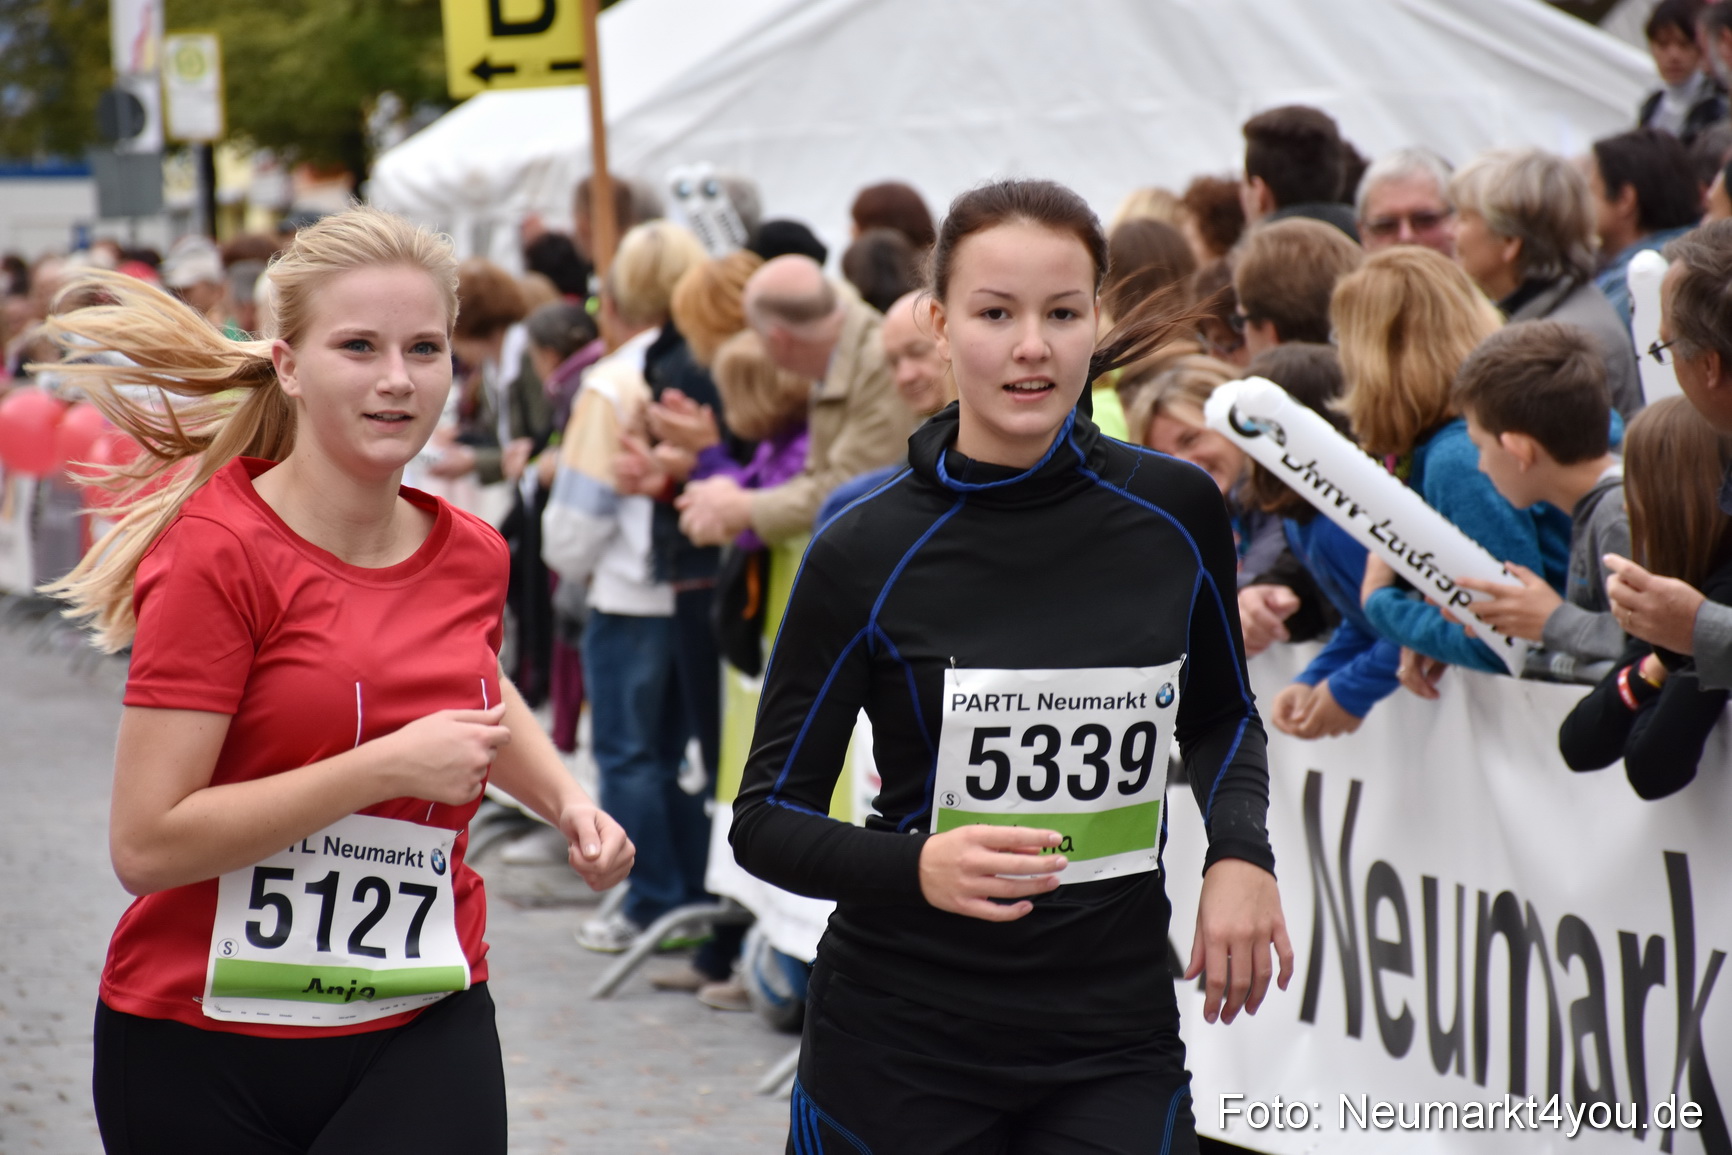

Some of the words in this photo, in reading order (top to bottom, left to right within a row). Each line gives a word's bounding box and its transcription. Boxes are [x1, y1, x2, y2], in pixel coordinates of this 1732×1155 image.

[951, 692, 1031, 712] PARTL
[1036, 691, 1148, 712] Neumarkt
[965, 720, 1158, 802] 5339
[322, 835, 424, 869] Neumarkt
[244, 866, 438, 959] 5127
